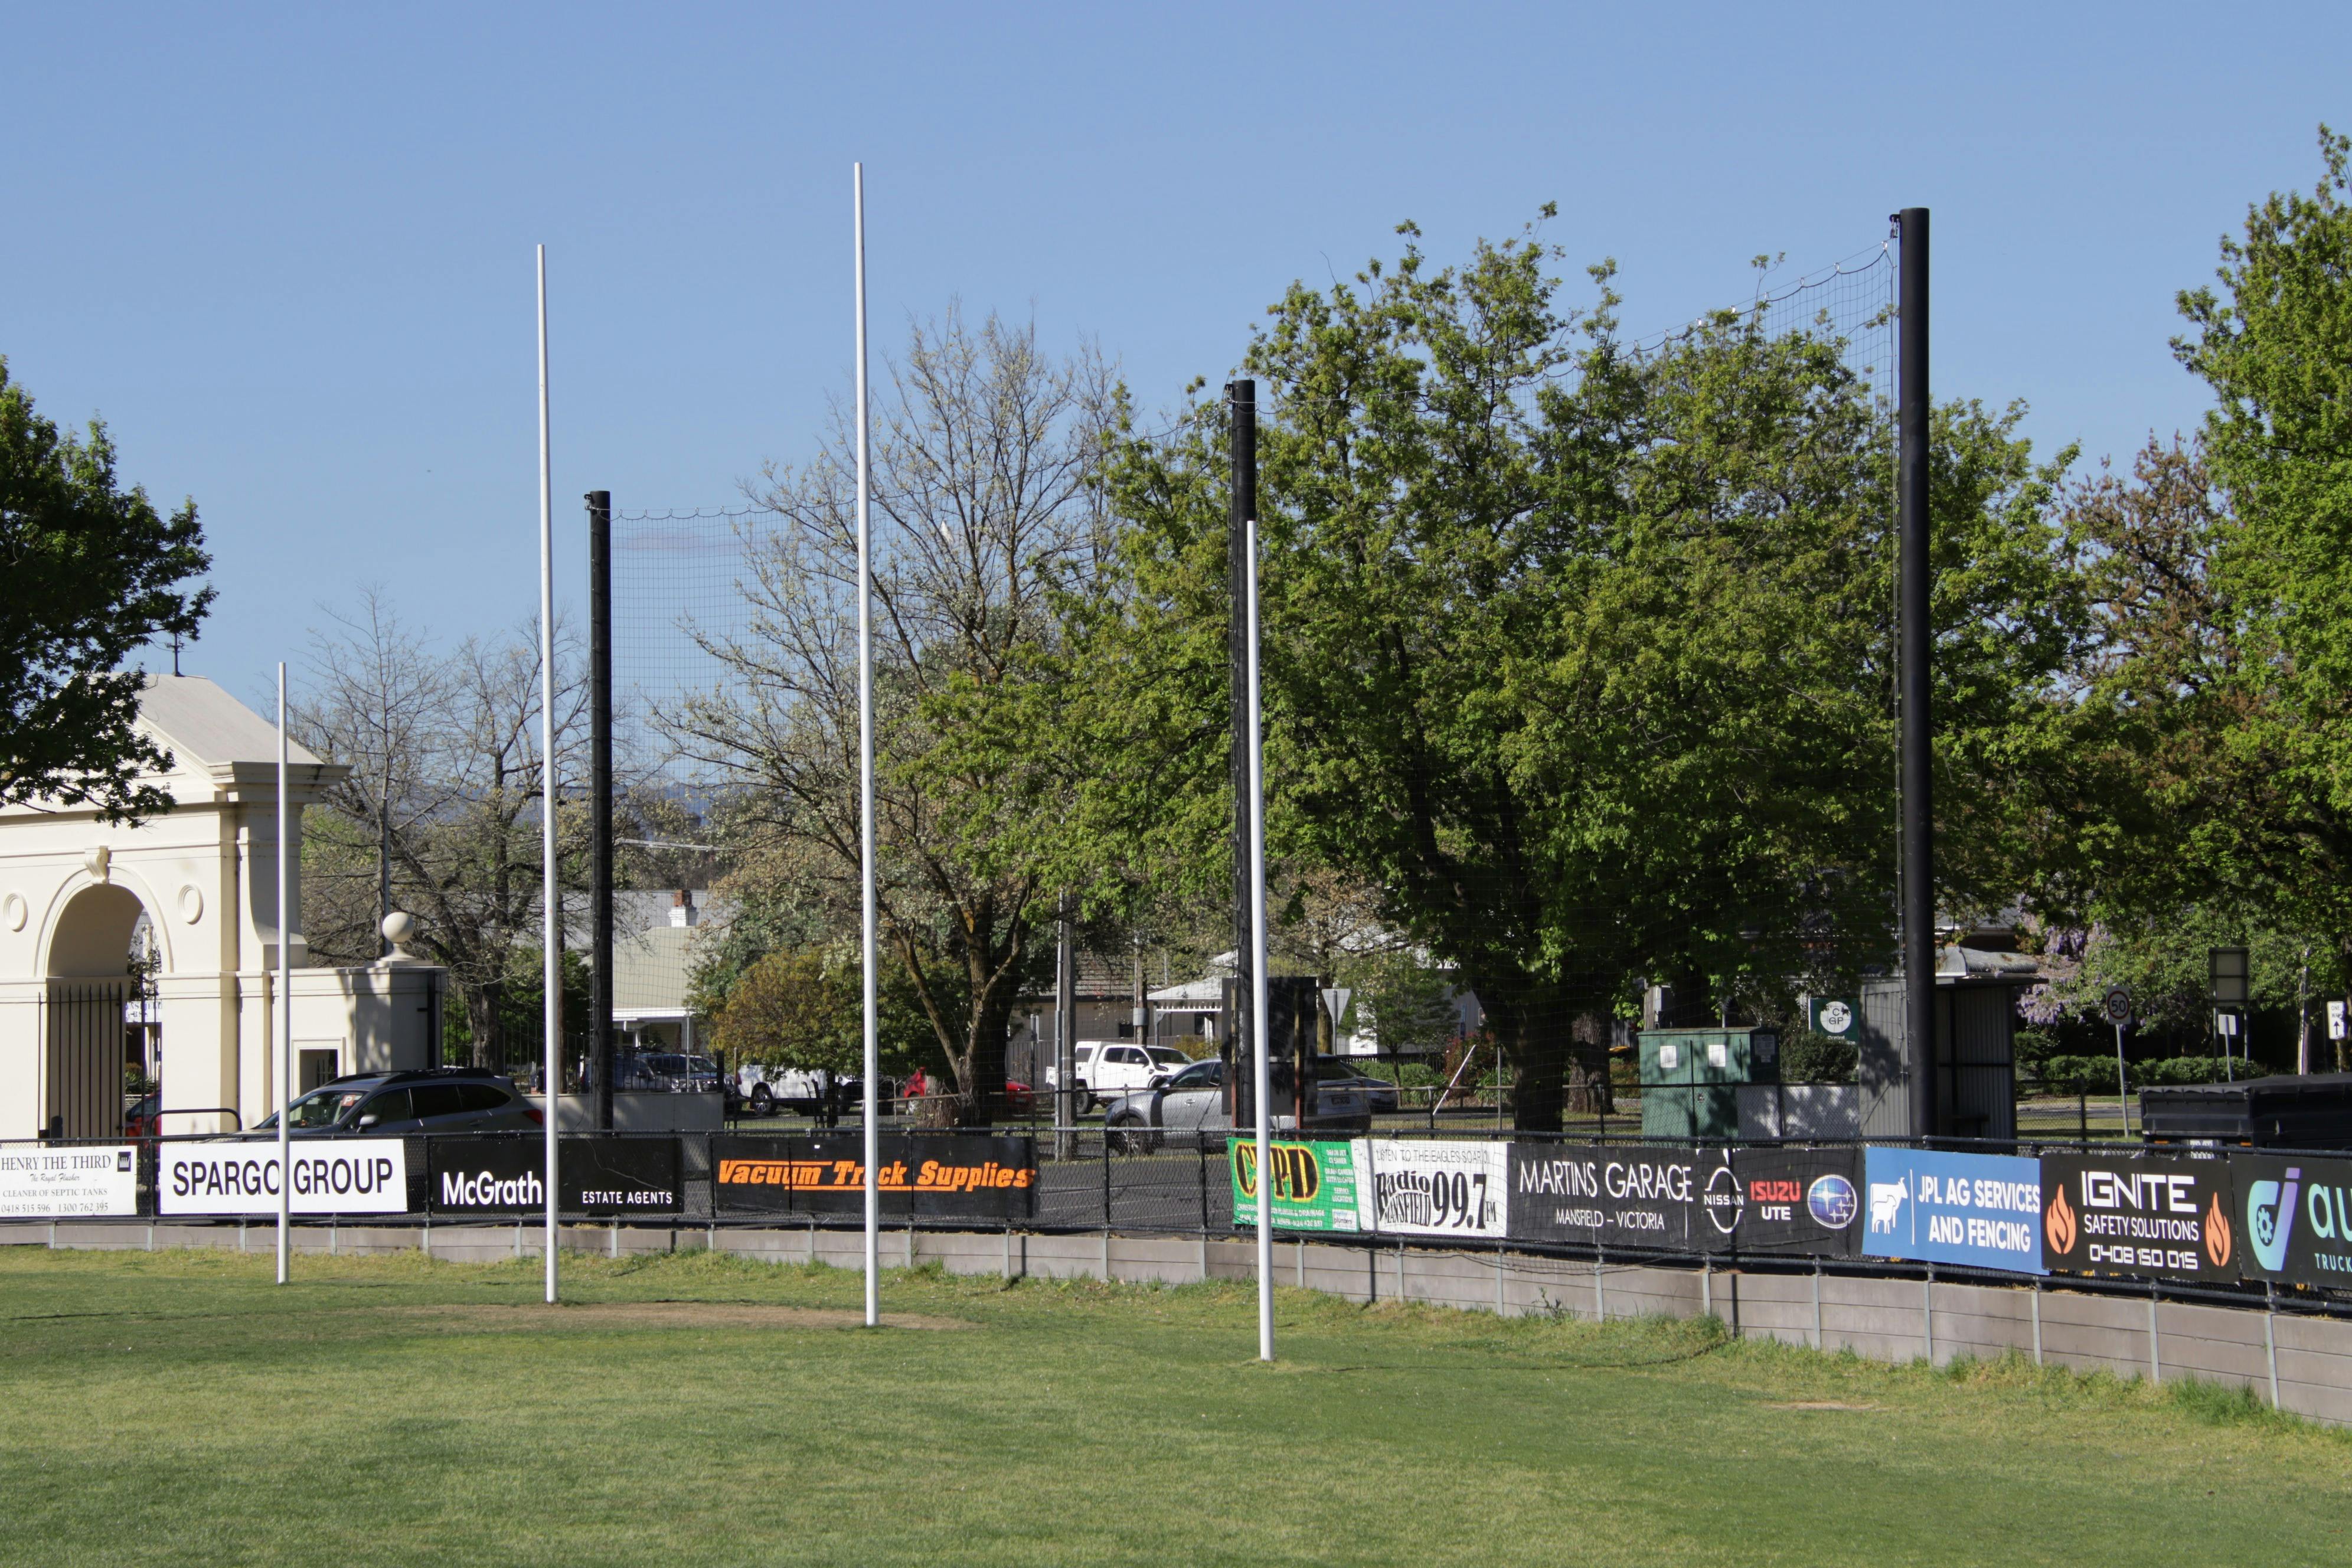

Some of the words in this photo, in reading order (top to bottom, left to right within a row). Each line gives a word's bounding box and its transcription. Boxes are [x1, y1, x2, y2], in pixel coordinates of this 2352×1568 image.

[1832, 1008, 1840, 1016] C
[2112, 1000, 2126, 1012] 50
[1, 1157, 39, 1170] HENRY
[43, 1157, 67, 1170] THE
[71, 1155, 111, 1170] THIRD
[1377, 1149, 1397, 1162] LISTEN
[1400, 1149, 1411, 1162] TO
[1414, 1150, 1429, 1162] THE
[1431, 1150, 1460, 1163] EAGLES
[1462, 1151, 1481, 1164] SOAR
[30, 1174, 38, 1182] The
[40, 1174, 57, 1184] Royal
[58, 1173, 80, 1182] Flusher
[173, 1159, 279, 1197] SPARGO
[293, 1158, 393, 1195] GROUP
[718, 1160, 822, 1185] Vacuum
[833, 1161, 907, 1185] Trck
[917, 1160, 1035, 1192] Supplies
[1236, 1145, 1318, 1198] CPD
[1520, 1160, 1598, 1197] MARTINS
[1605, 1162, 1693, 1201] GARAGE
[443, 1171, 542, 1205] McGrath
[582, 1191, 623, 1204] ESTATE
[627, 1191, 672, 1204] AGENTS
[1375, 1171, 1430, 1221] Radio
[1432, 1171, 1487, 1229] 99.7
[1704, 1195, 1744, 1206] NISSAN
[1750, 1181, 1801, 1201] ISUZU
[1918, 1176, 1942, 1204] JPL
[1946, 1178, 1971, 1206] AG
[1974, 1180, 2040, 1213] SERVICES
[2082, 1171, 2197, 1213] IGNITE
[1, 1204, 19, 1213] 0418
[22, 1204, 37, 1213] 515
[37, 1204, 51, 1213] 596
[58, 1203, 77, 1213] 1300
[80, 1203, 93, 1211] 762
[95, 1202, 109, 1211] 395
[1385, 1193, 1431, 1227] MANSFIELD
[1556, 1208, 1603, 1227] MANSFIELD
[1616, 1211, 1665, 1230] VICTORIA
[1762, 1206, 1791, 1220] UTE
[1929, 1215, 1964, 1244] AND
[1968, 1219, 2031, 1252] FENCING
[2084, 1214, 2129, 1236] SAFETY
[2131, 1217, 2199, 1242] SOLUTIONS
[2089, 1244, 2134, 1264] 0408
[2137, 1248, 2164, 1267] 150
[2167, 1250, 2198, 1269] 015
